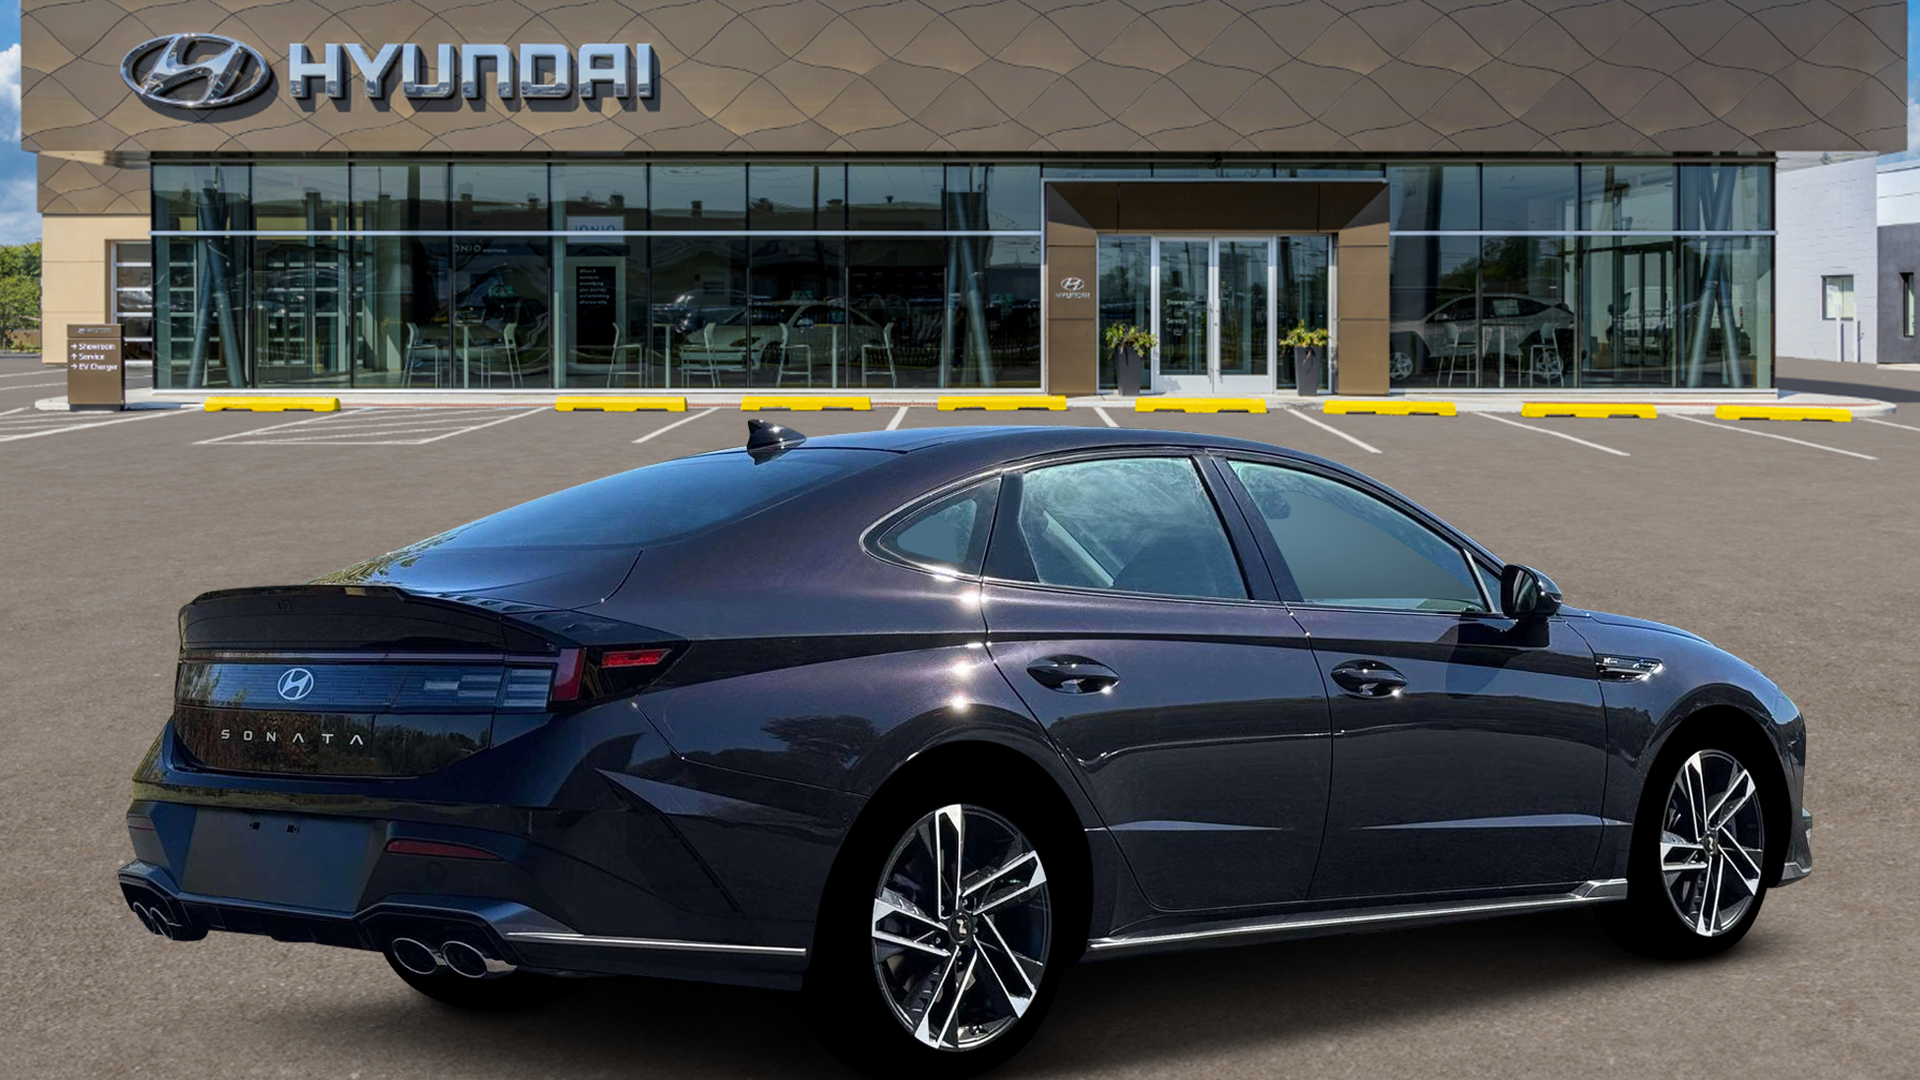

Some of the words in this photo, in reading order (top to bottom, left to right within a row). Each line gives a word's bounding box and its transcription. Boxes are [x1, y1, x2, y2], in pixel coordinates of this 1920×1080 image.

[289, 43, 654, 99] HYUNDAI
[90, 363, 118, 372] Charger
[221, 729, 364, 745] SONATA
